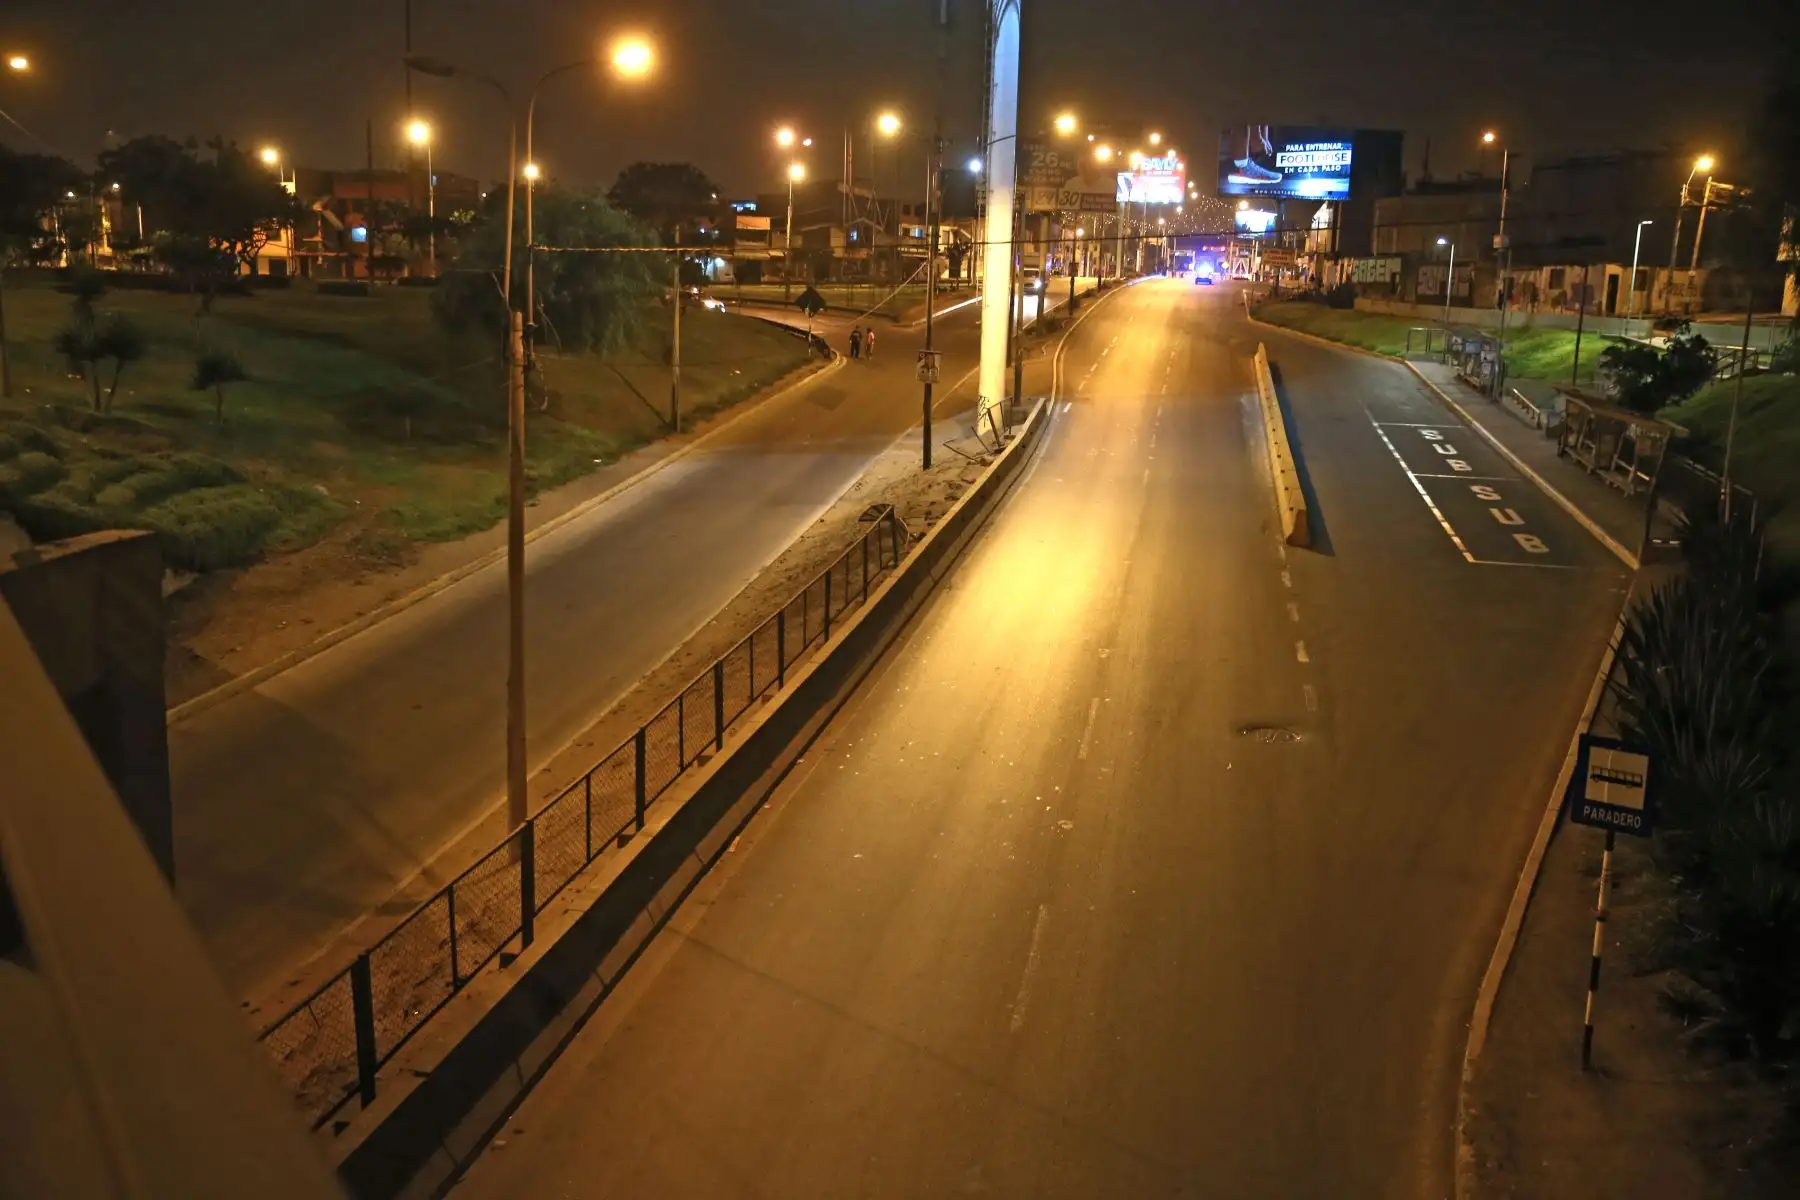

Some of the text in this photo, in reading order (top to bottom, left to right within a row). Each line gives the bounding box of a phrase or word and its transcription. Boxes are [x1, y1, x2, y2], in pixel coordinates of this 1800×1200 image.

[1286, 144, 1304, 152] PARA
[1031, 152, 1059, 167] 26
[1321, 164, 1342, 172] PASO
[1058, 190, 1080, 206] 30
[1583, 804, 1642, 829] PARADERO
